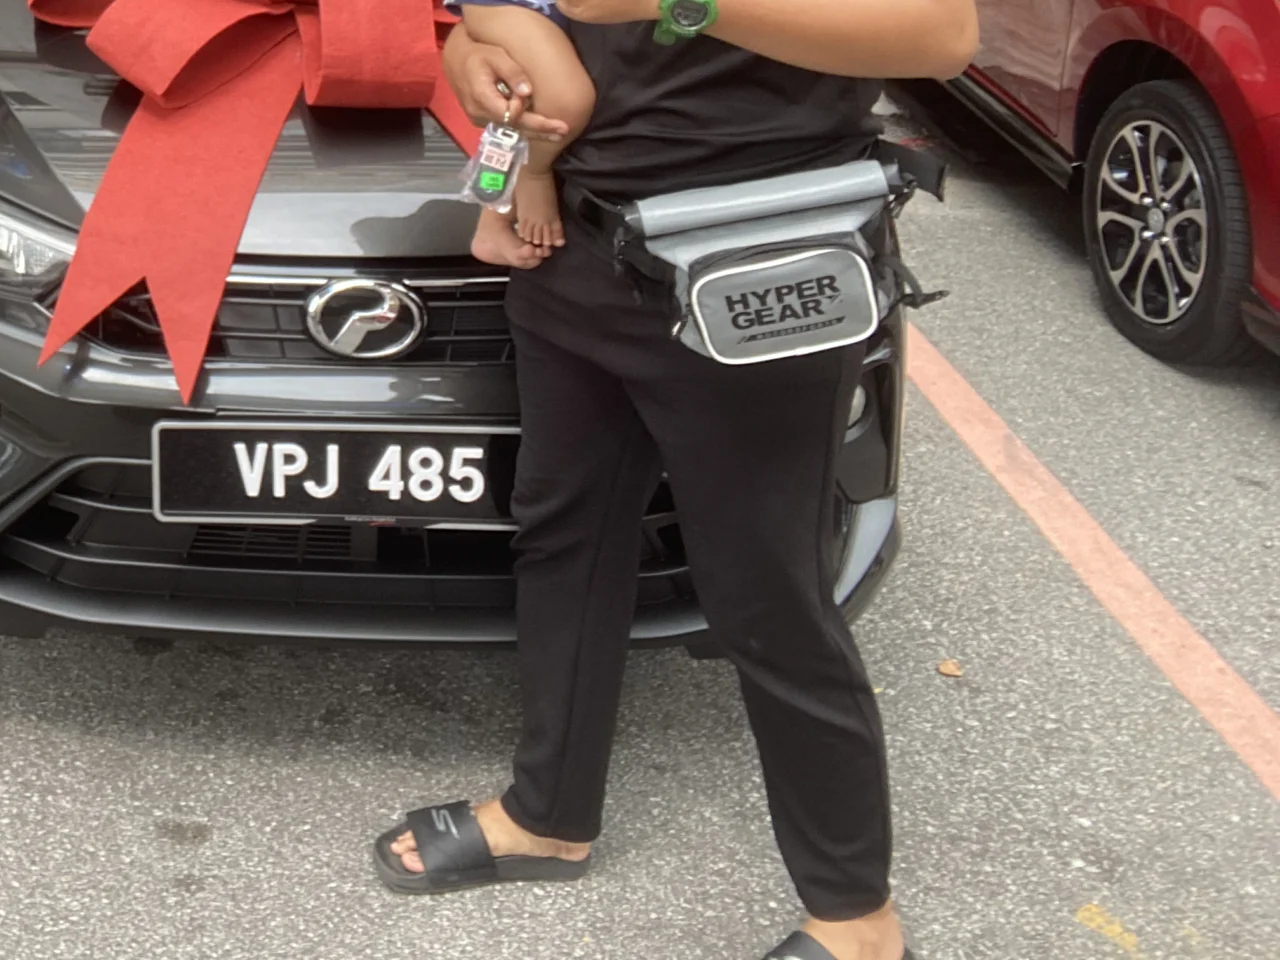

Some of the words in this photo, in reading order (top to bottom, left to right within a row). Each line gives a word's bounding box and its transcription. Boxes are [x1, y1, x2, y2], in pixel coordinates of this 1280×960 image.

[724, 274, 841, 314] HYPER
[731, 298, 825, 331] GEAR
[233, 442, 340, 499] VPJ
[367, 444, 486, 503] 485
